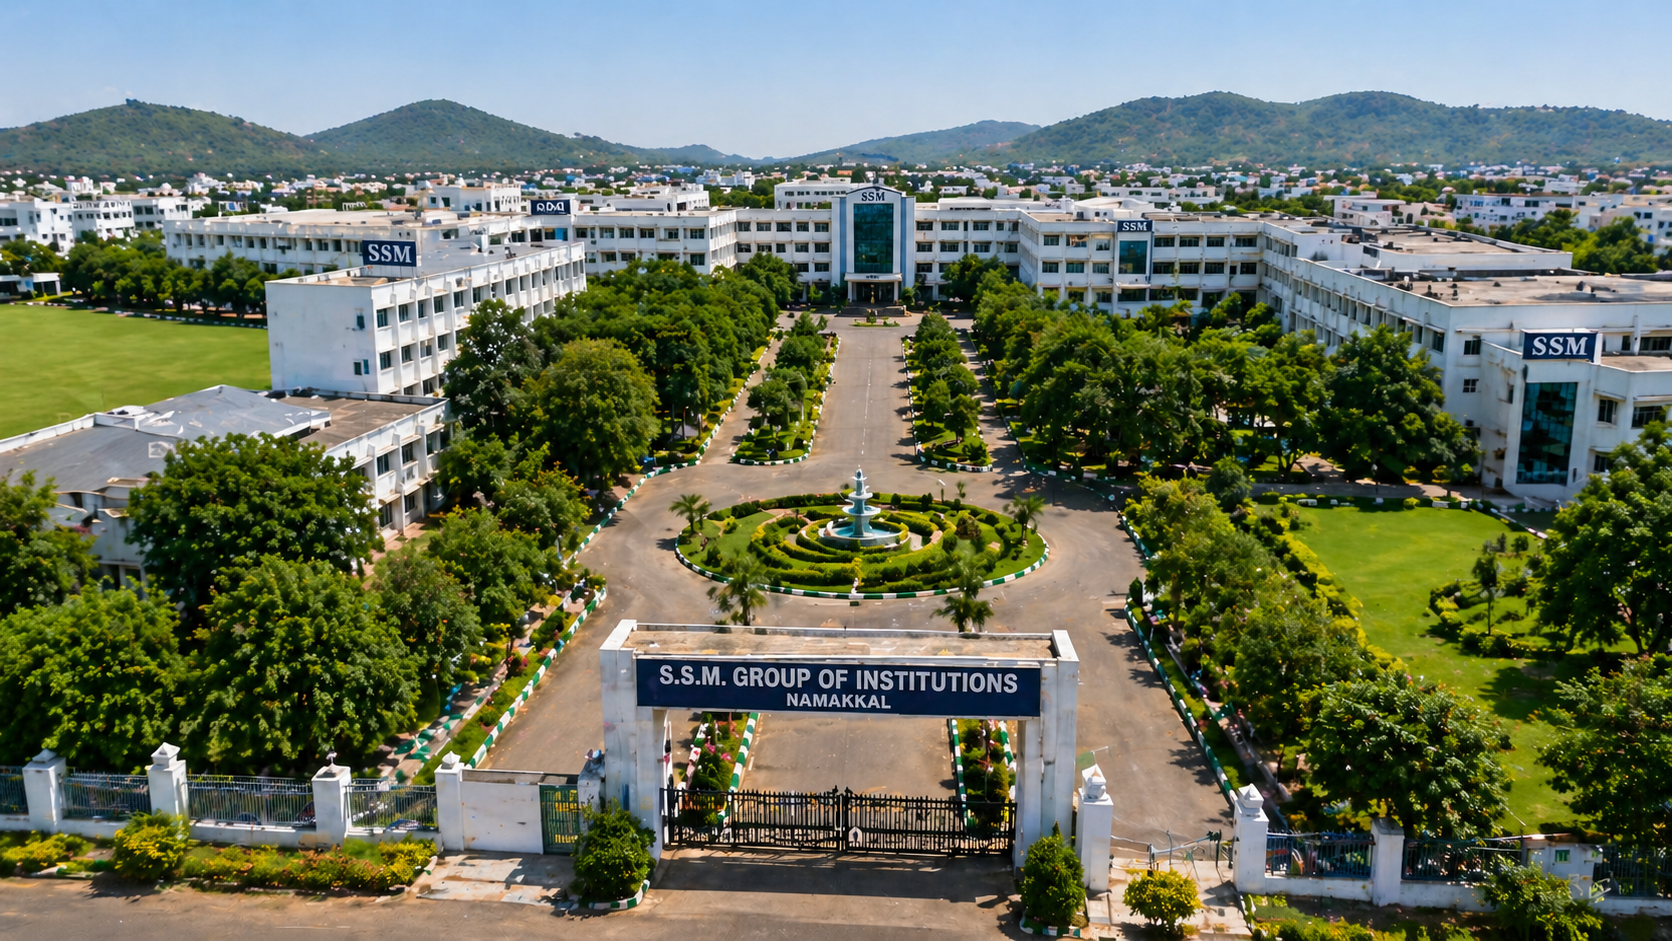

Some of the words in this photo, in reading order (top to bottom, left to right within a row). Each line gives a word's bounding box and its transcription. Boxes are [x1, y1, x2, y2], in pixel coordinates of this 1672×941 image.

[861, 191, 885, 202] SSM
[1122, 221, 1148, 231] SSM
[368, 243, 412, 263] SSM
[1532, 336, 1588, 356] SSM
[659, 664, 727, 686] S.S.M.
[732, 666, 811, 688] GROUP
[818, 668, 849, 690] OF
[856, 669, 1018, 694] INSTITUTIONS
[786, 692, 892, 709] NAMAKKAL
